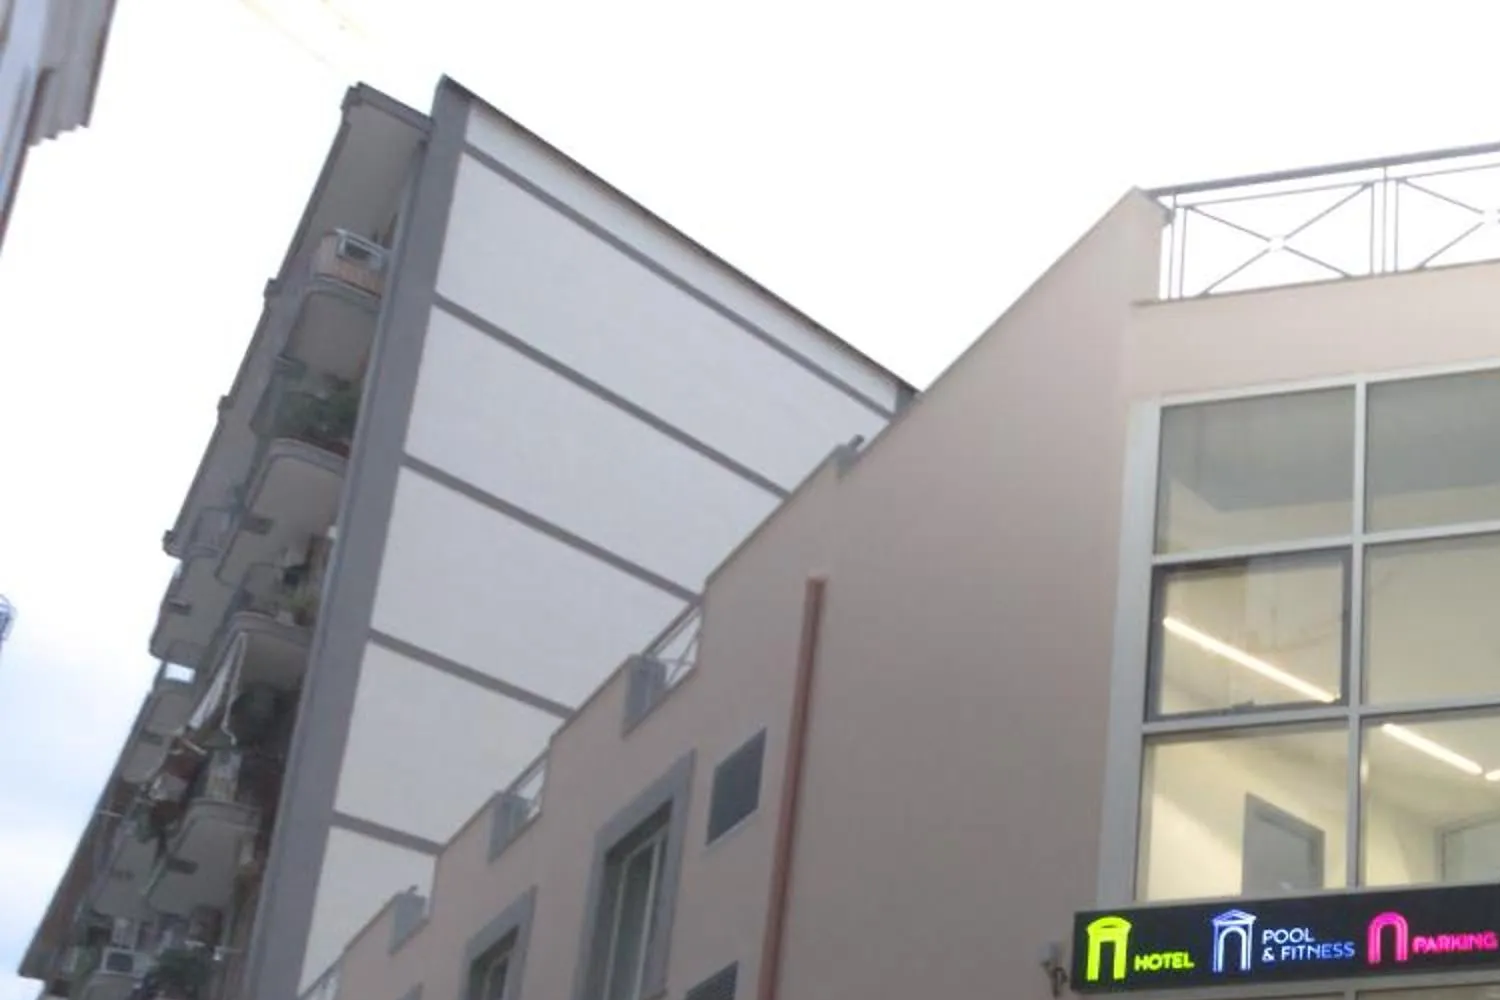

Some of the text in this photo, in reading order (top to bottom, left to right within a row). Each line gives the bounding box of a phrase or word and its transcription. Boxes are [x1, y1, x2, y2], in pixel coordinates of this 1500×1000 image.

[1262, 928, 1315, 945] POOL
[1412, 931, 1498, 953] PARKING
[1133, 950, 1195, 972] HOTEL
[1262, 941, 1355, 962] & FITNESS
